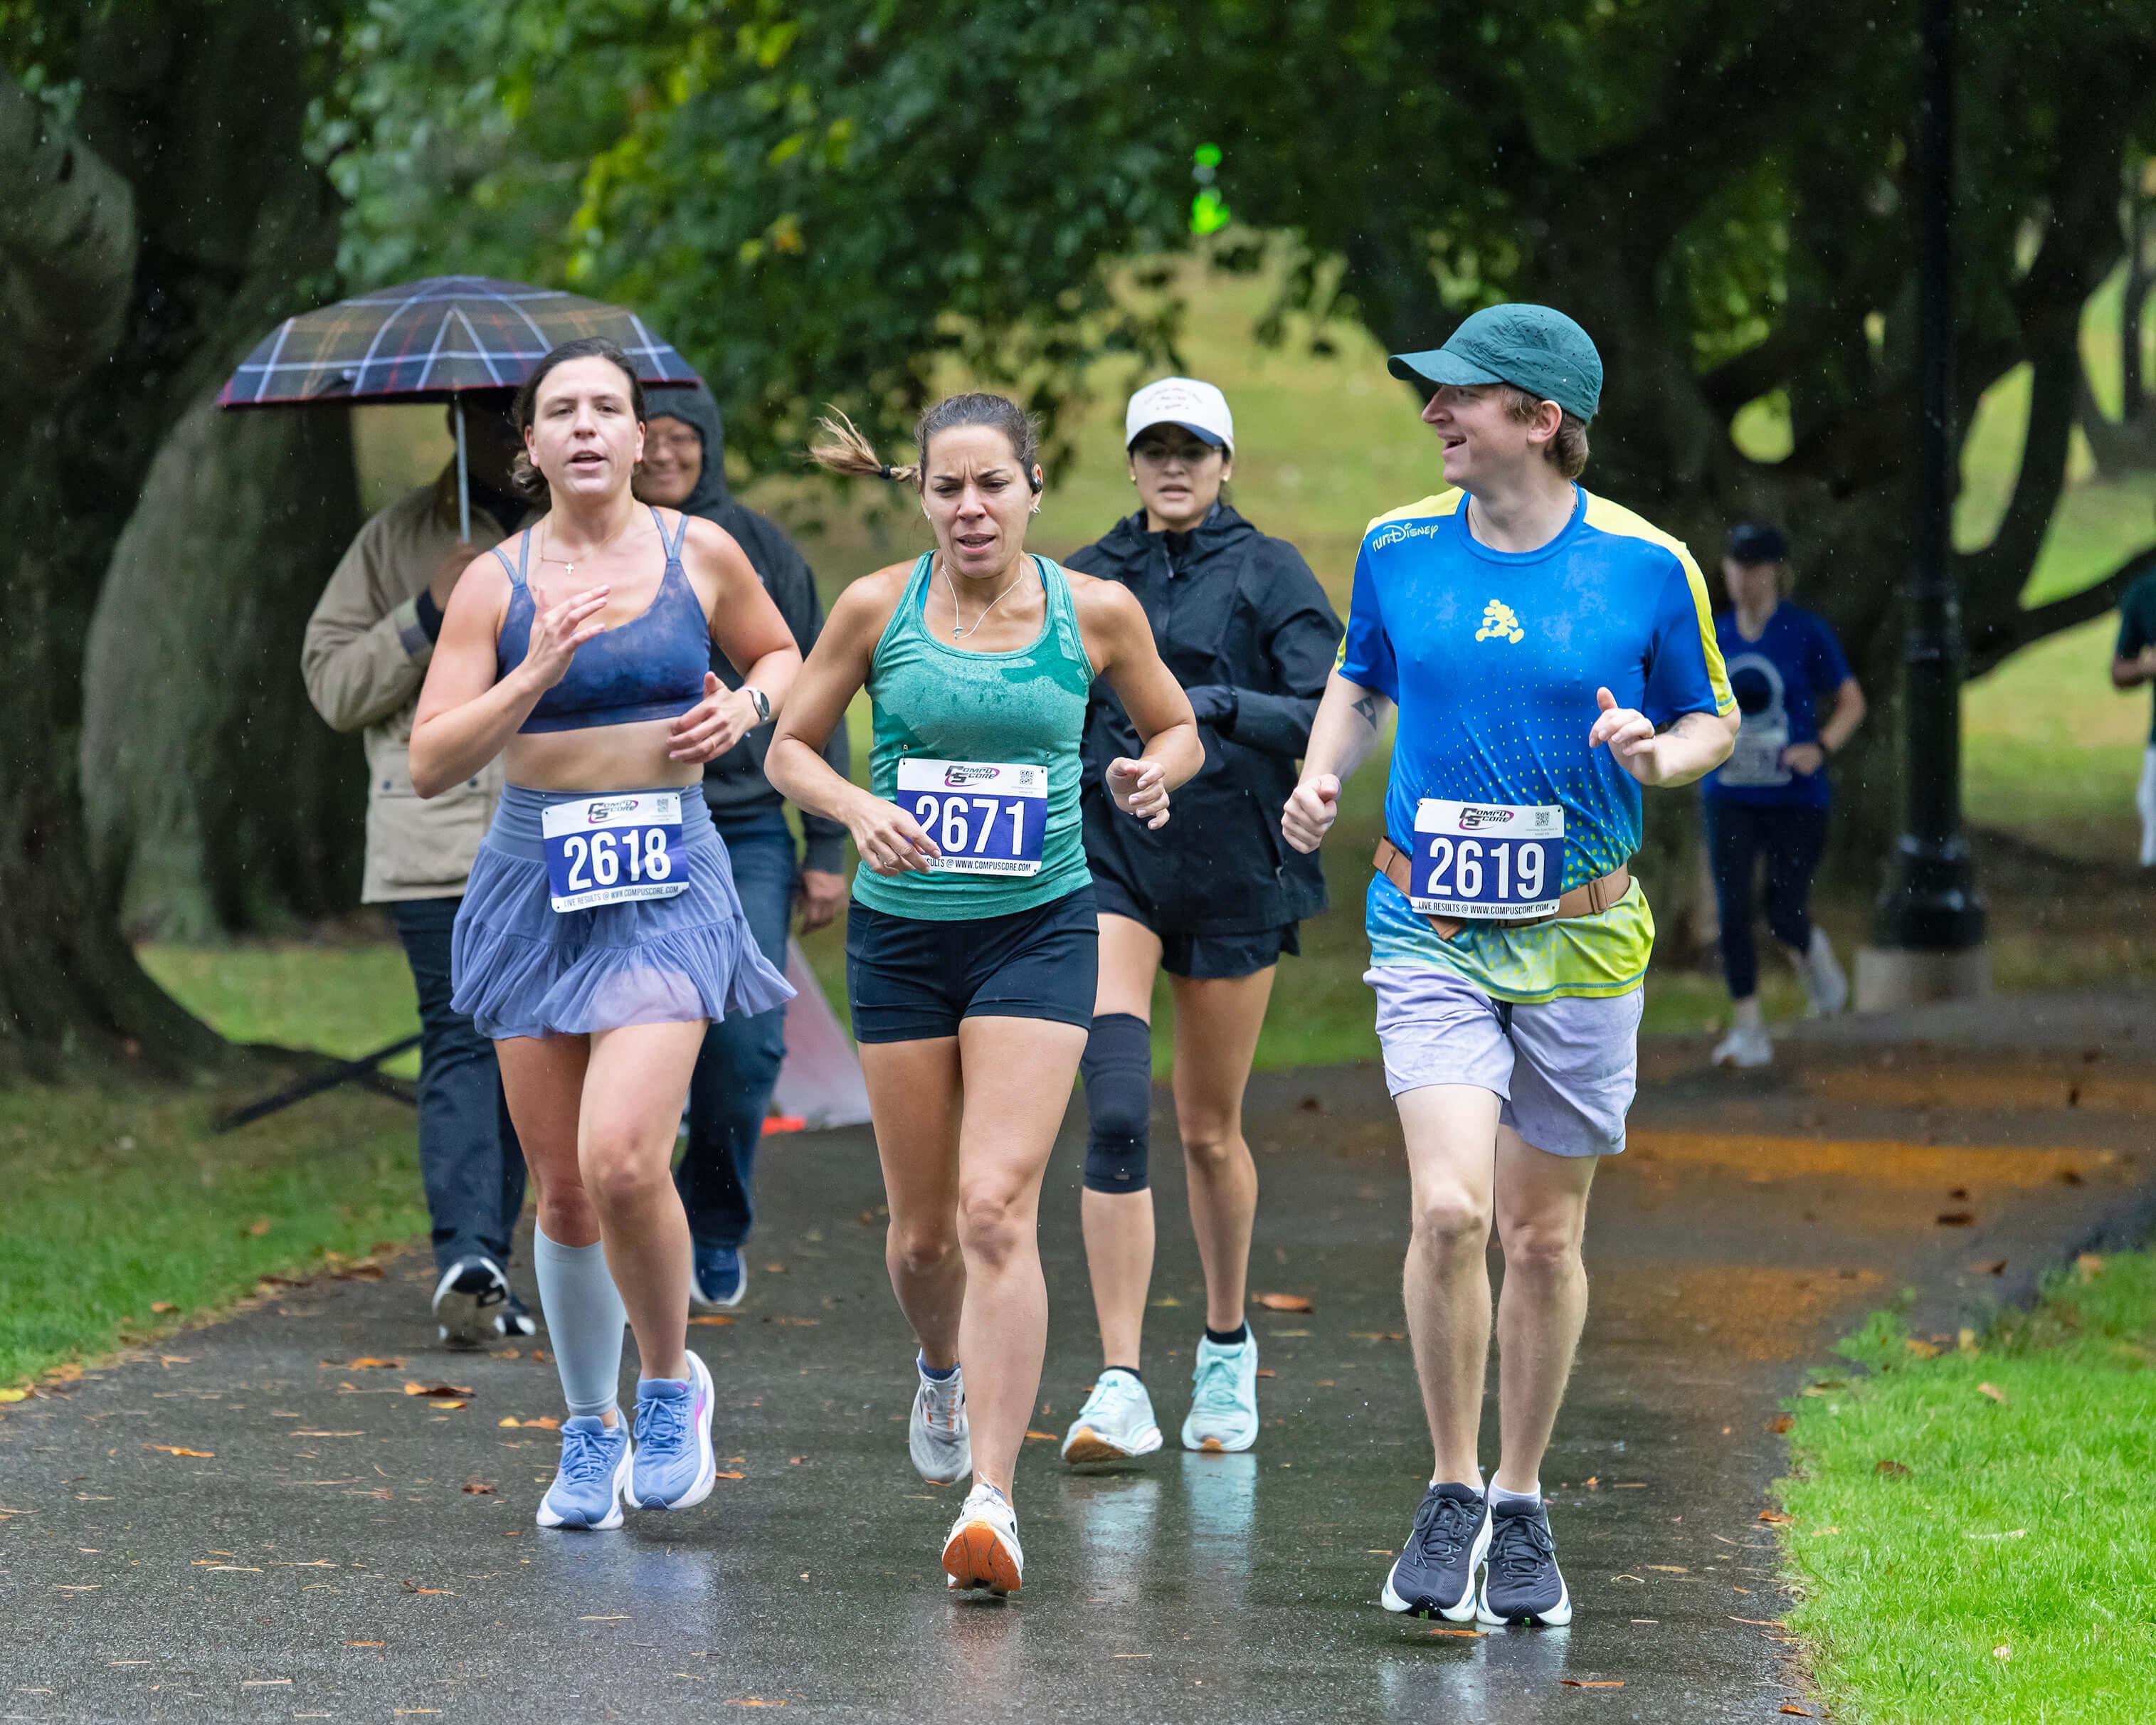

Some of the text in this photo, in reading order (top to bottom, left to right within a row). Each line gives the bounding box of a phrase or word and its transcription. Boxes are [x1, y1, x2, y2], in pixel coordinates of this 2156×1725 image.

[916, 795, 1025, 855] 2671
[564, 828, 671, 891] 2618
[926, 858, 1031, 872] SULTS @ WWW.COMPUSCORE.COM
[1427, 837, 1545, 900] 2619
[564, 897, 576, 907] LIVE
[577, 893, 601, 904] RESULTS
[611, 885, 679, 900] WWW.COMPUSCORE.COM
[1418, 901, 1549, 915] LIVE RESULTS @ WWW.COMPUSCORE.COM
